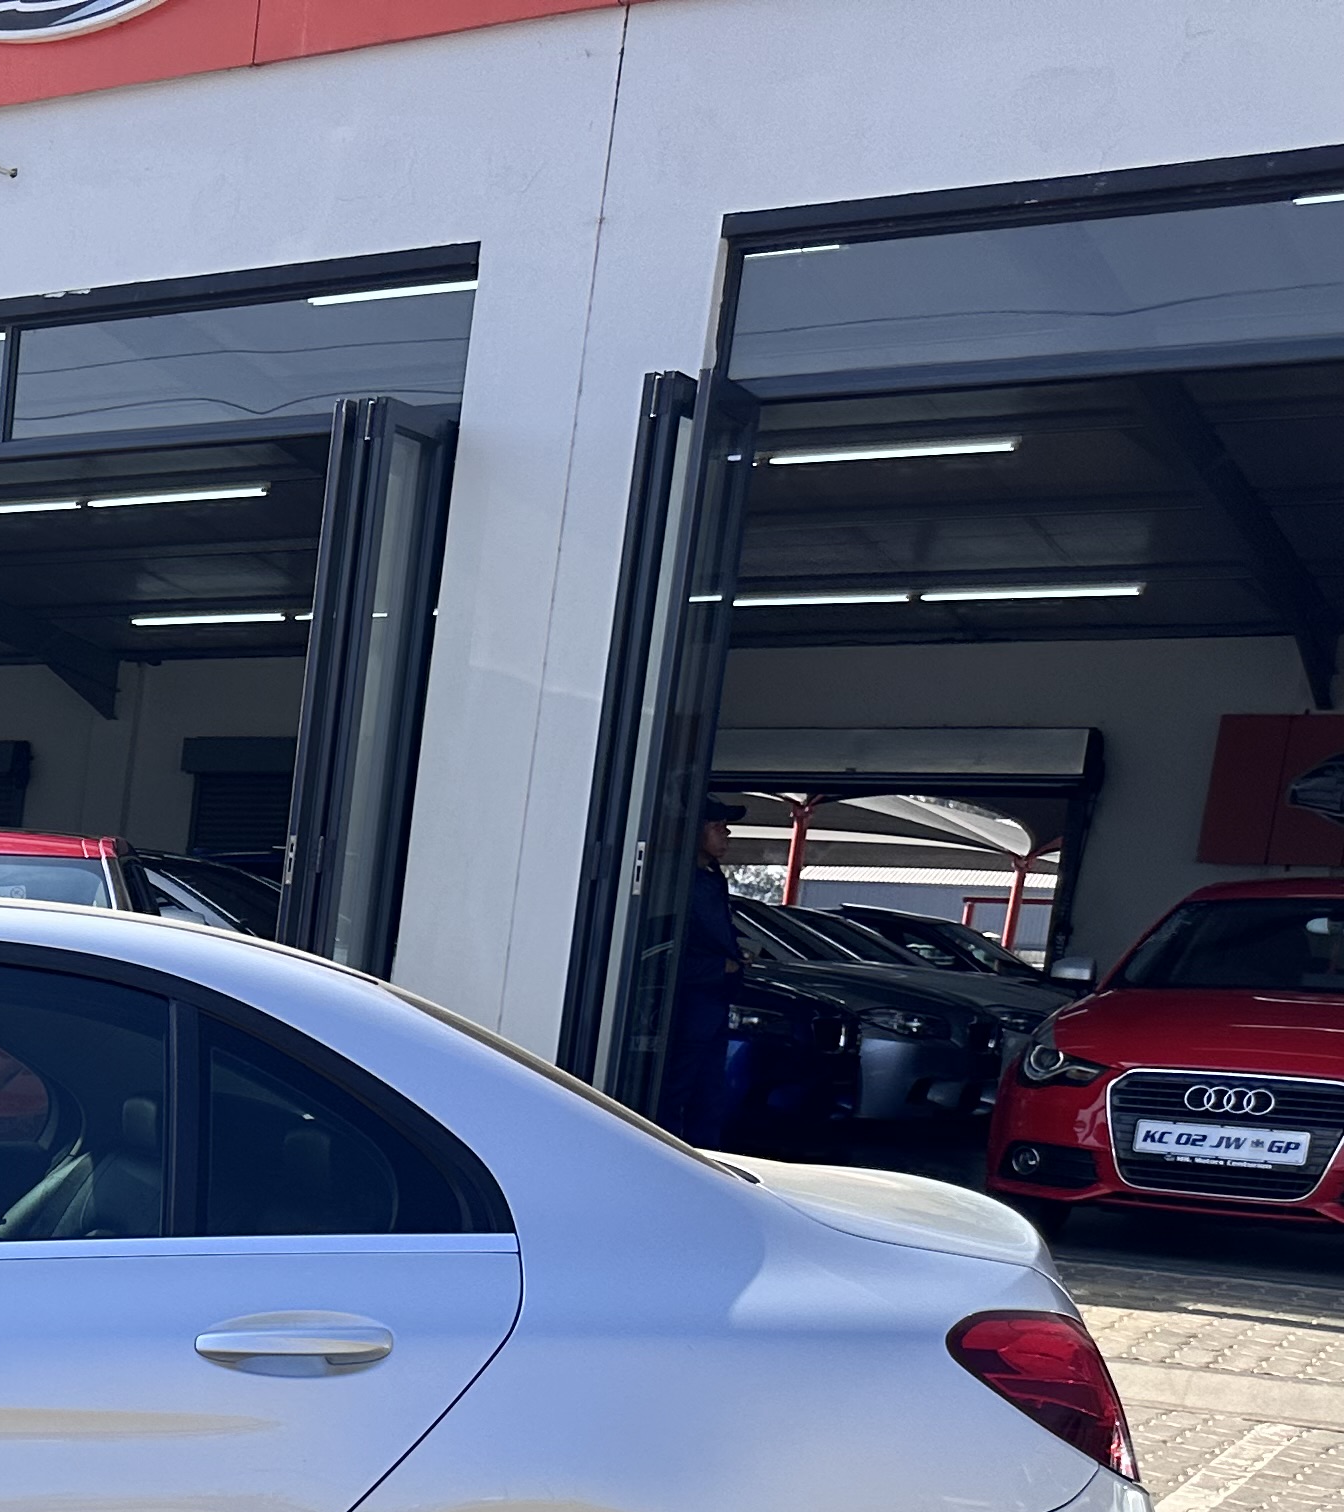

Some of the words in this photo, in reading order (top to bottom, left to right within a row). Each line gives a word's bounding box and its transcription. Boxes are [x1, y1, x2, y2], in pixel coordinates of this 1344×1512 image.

[1141, 1129, 1172, 1144] KC
[1175, 1132, 1208, 1147] 02
[1209, 1136, 1247, 1150] JW
[1267, 1139, 1301, 1154] GP
